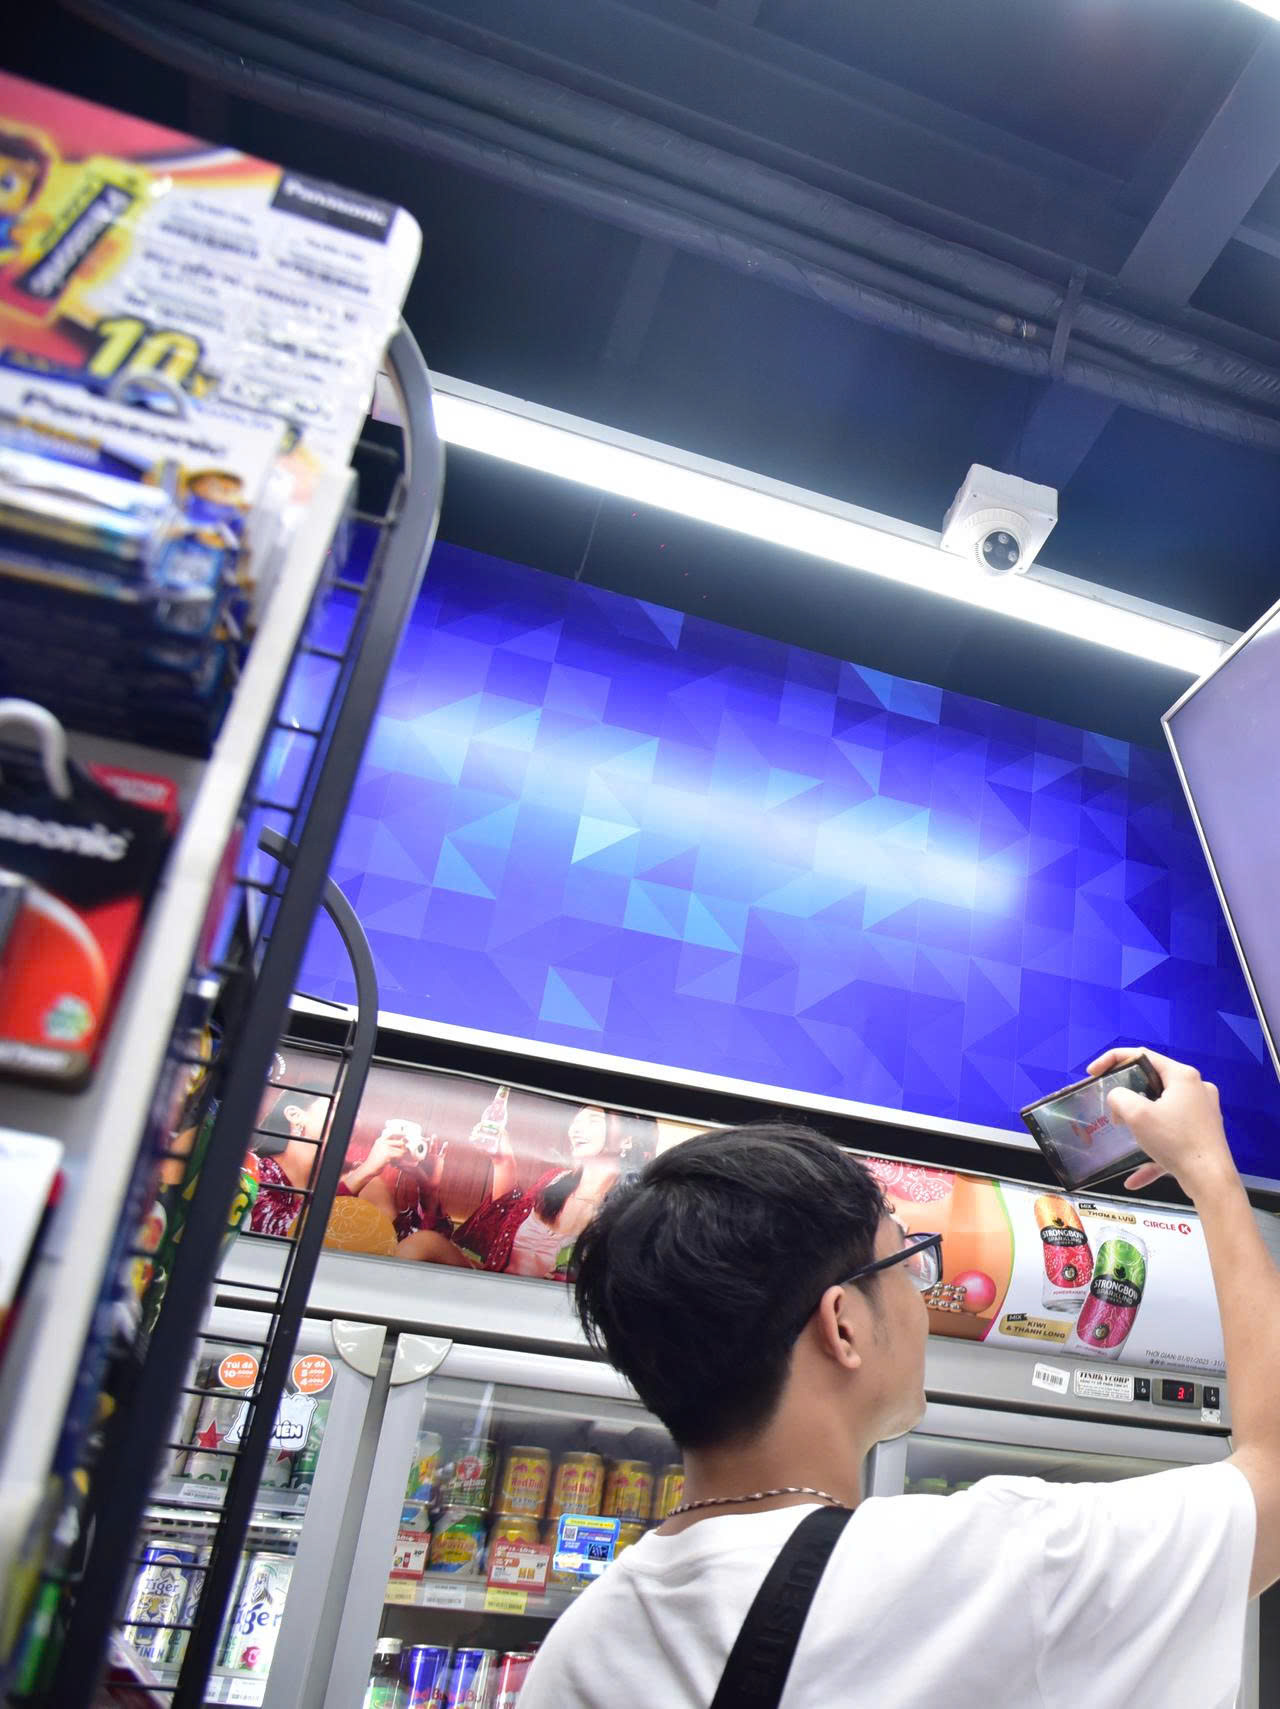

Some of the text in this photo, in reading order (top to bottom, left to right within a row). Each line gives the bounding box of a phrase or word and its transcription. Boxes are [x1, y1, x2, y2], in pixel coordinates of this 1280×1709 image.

[1143, 1219, 1177, 1232] CIRCLE
[1041, 1228, 1084, 1240] STRONGBOW
[1094, 1279, 1139, 1300] STRONGBOW
[1027, 1321, 1047, 1329] KIWI
[1014, 1326, 1041, 1335] THANH
[1043, 1330, 1066, 1338] LONG
[301, 1361, 314, 1370] Ly
[232, 1602, 283, 1636] iger
